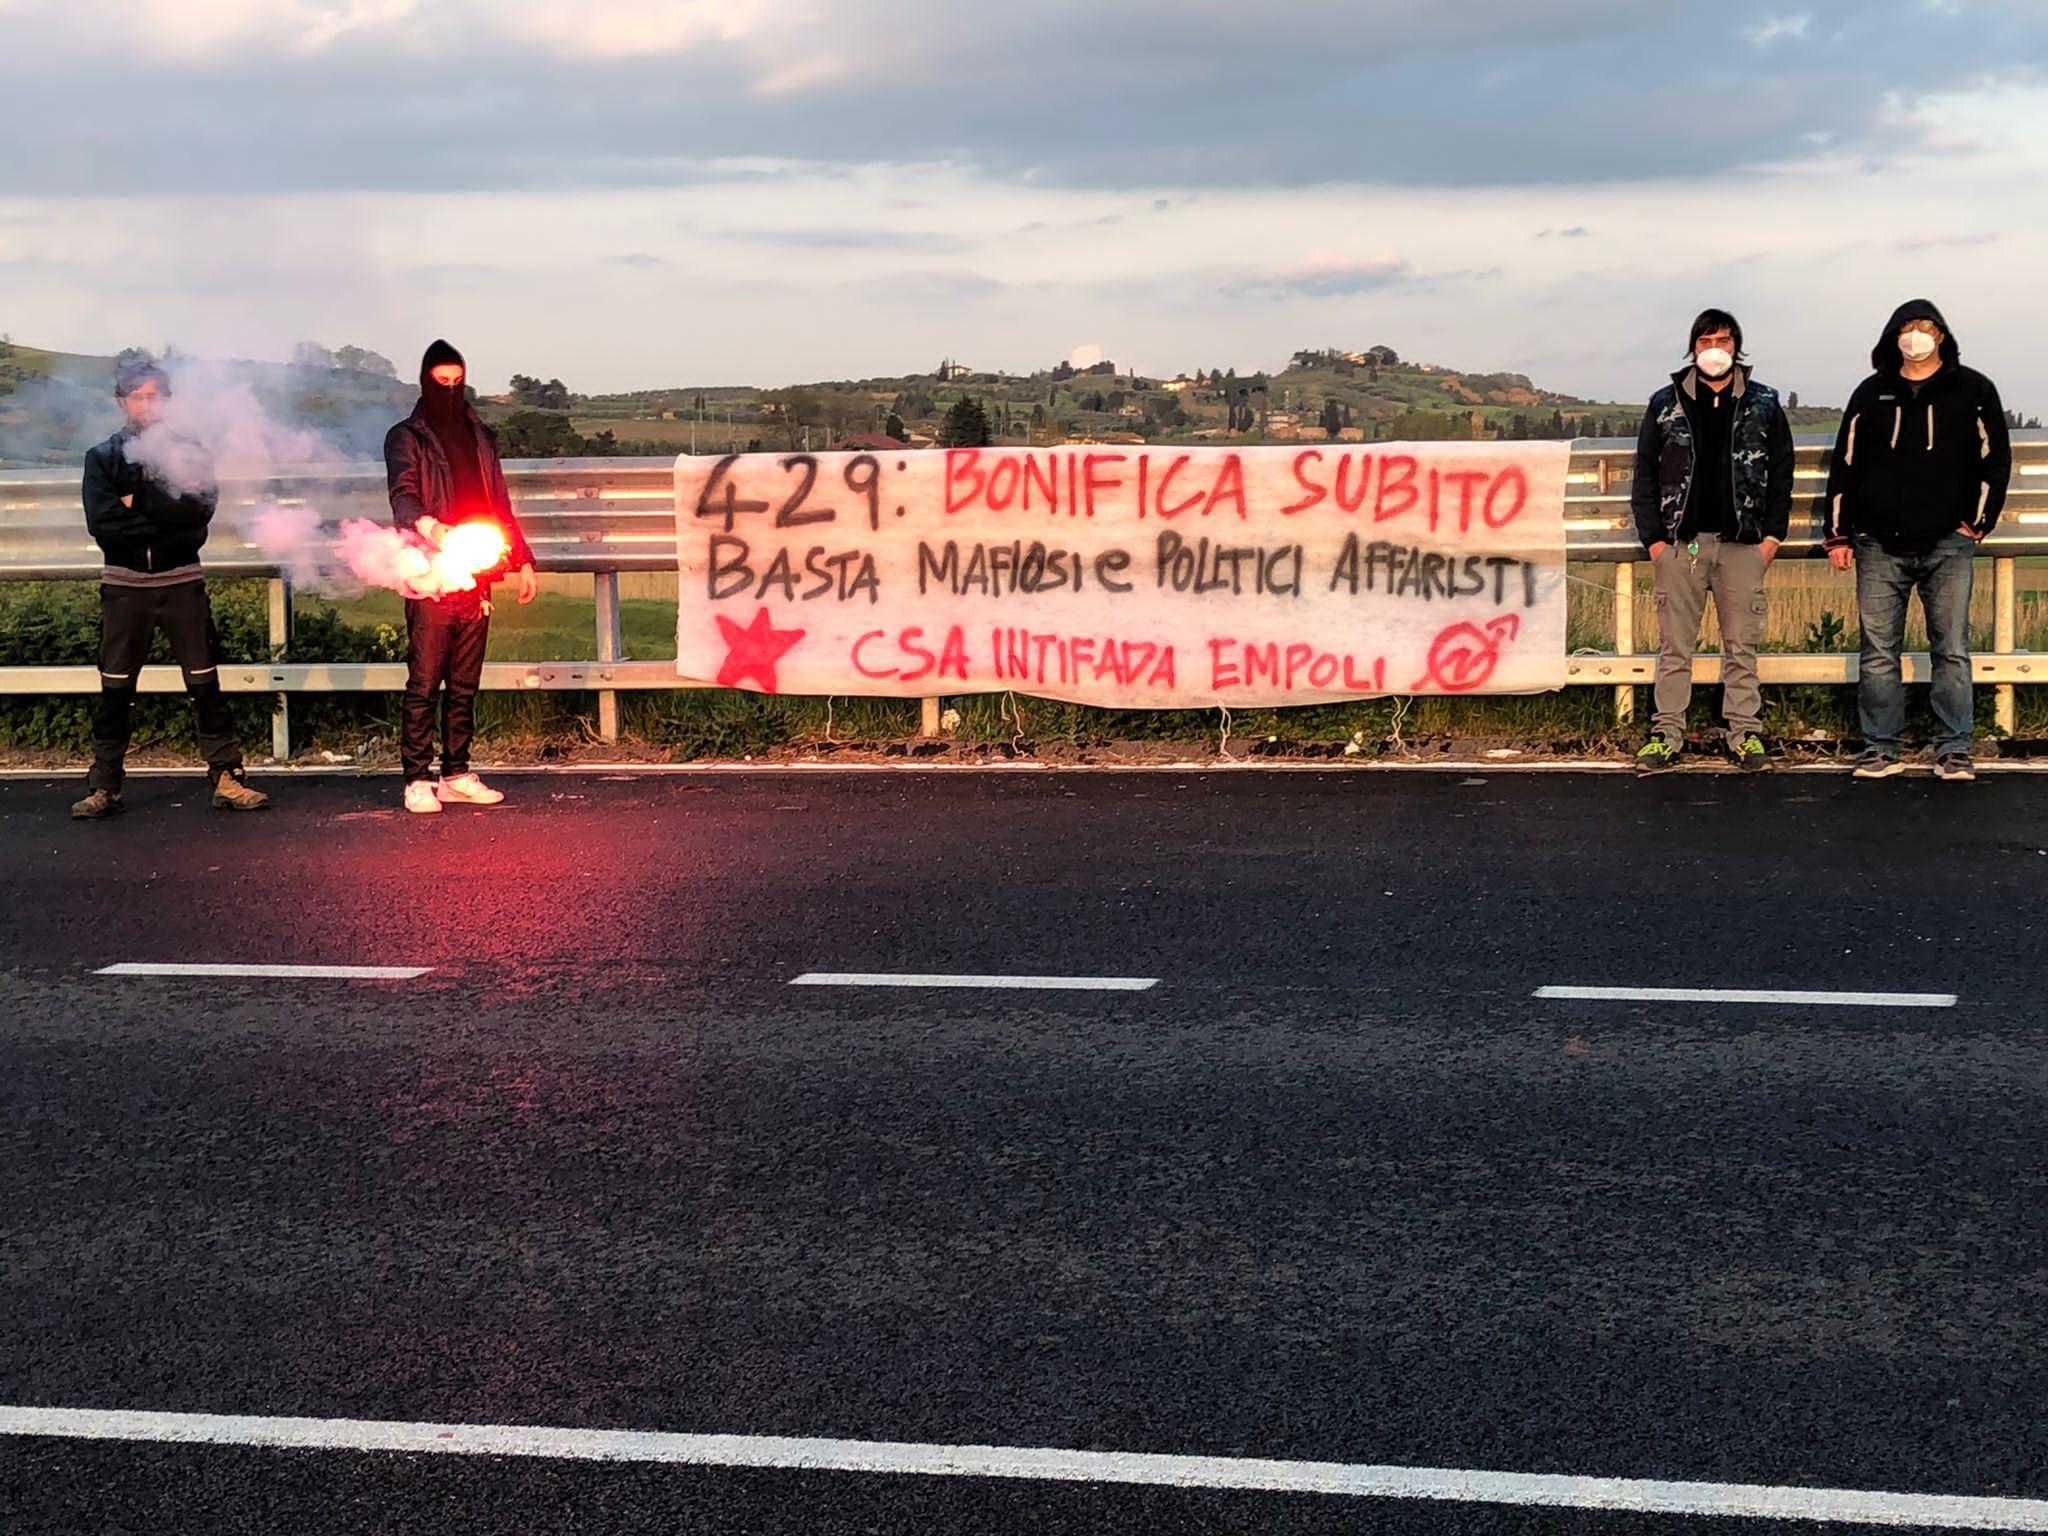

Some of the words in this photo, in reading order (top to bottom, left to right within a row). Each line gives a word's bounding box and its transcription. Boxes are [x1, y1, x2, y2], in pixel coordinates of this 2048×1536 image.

[695, 454, 907, 533] 429:
[944, 447, 1247, 521] BONIFICA
[1280, 449, 1529, 533] SUBITO
[707, 533, 881, 604] BASTA
[917, 538, 1083, 599] MAFIOSI
[1095, 548, 1134, 594] e
[1156, 528, 1304, 598] POLITICI
[1328, 531, 1537, 608] AFFARISTI
[850, 625, 971, 683] CSA
[992, 626, 1177, 690] INTIFADA
[1206, 637, 1386, 692] EMPOLI
